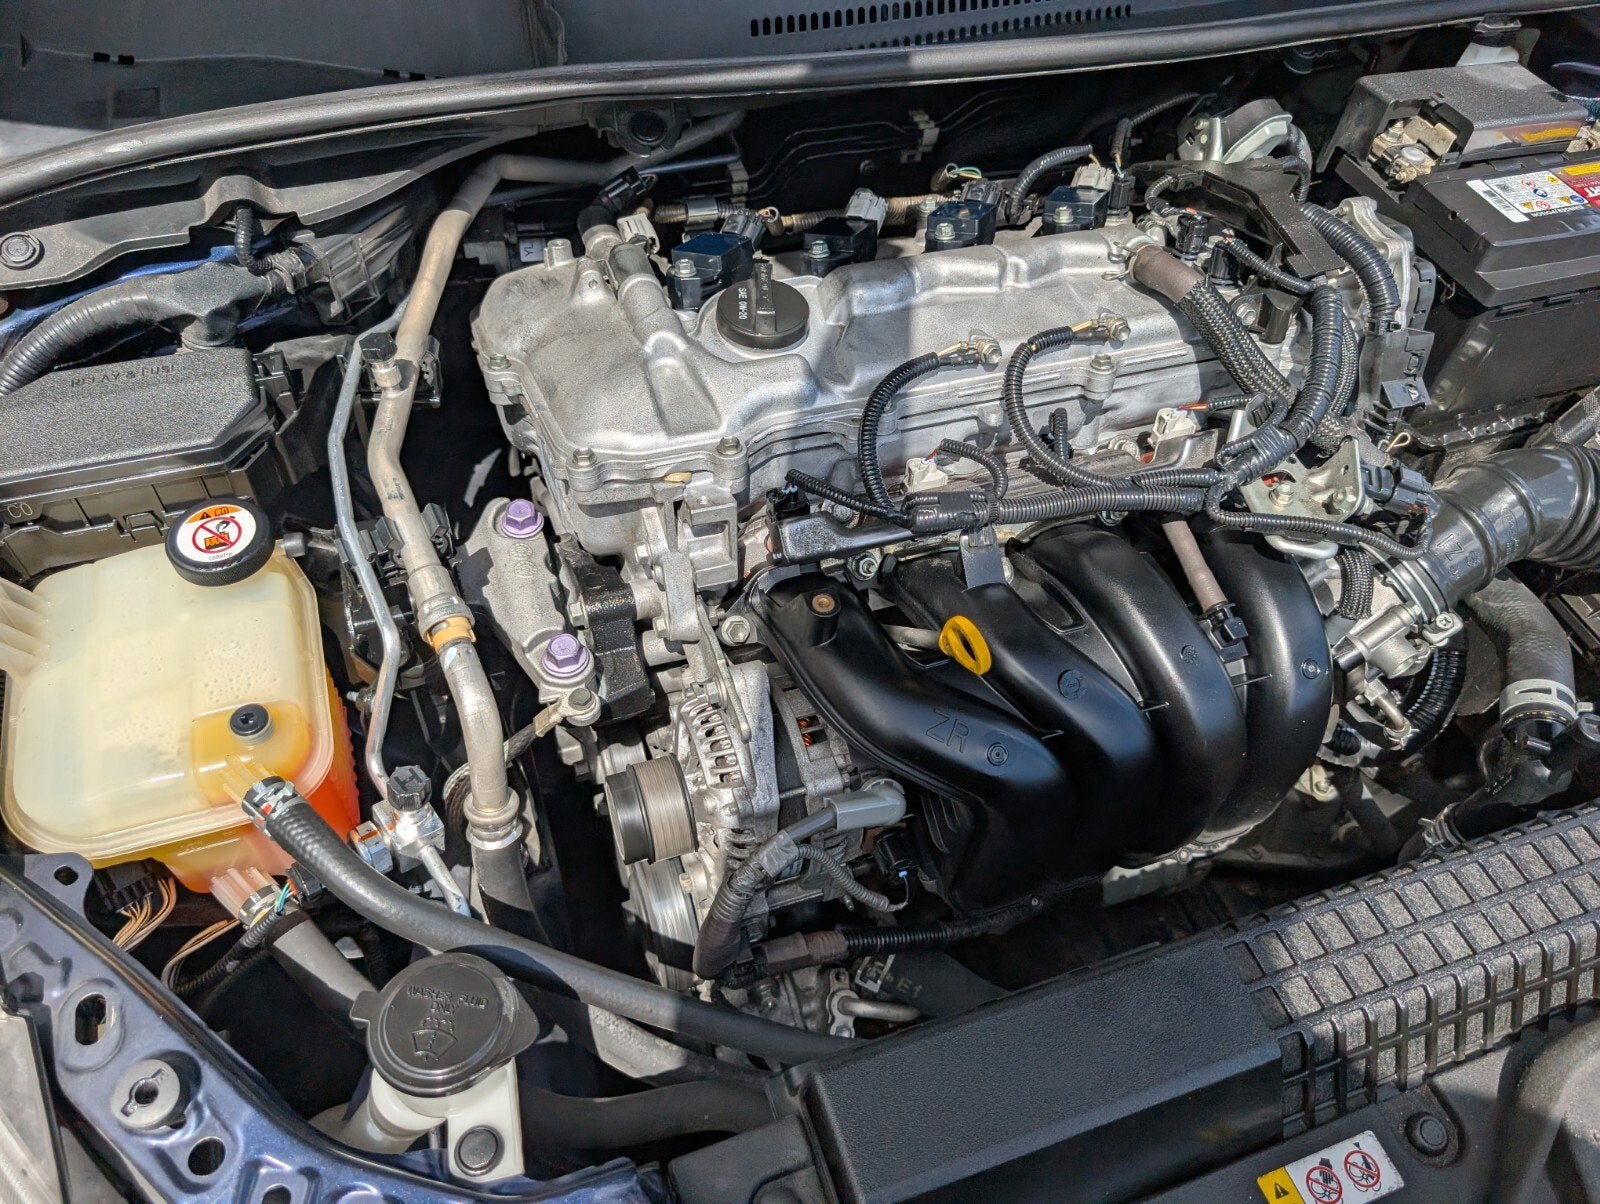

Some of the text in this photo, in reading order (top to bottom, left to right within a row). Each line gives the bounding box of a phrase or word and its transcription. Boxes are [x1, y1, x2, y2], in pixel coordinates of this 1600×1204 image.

[738, 287, 748, 320] SAE 0W-20
[925, 708, 970, 754] ZR
[393, 767, 424, 793] H
[407, 984, 490, 1010] WASHER FLUID
